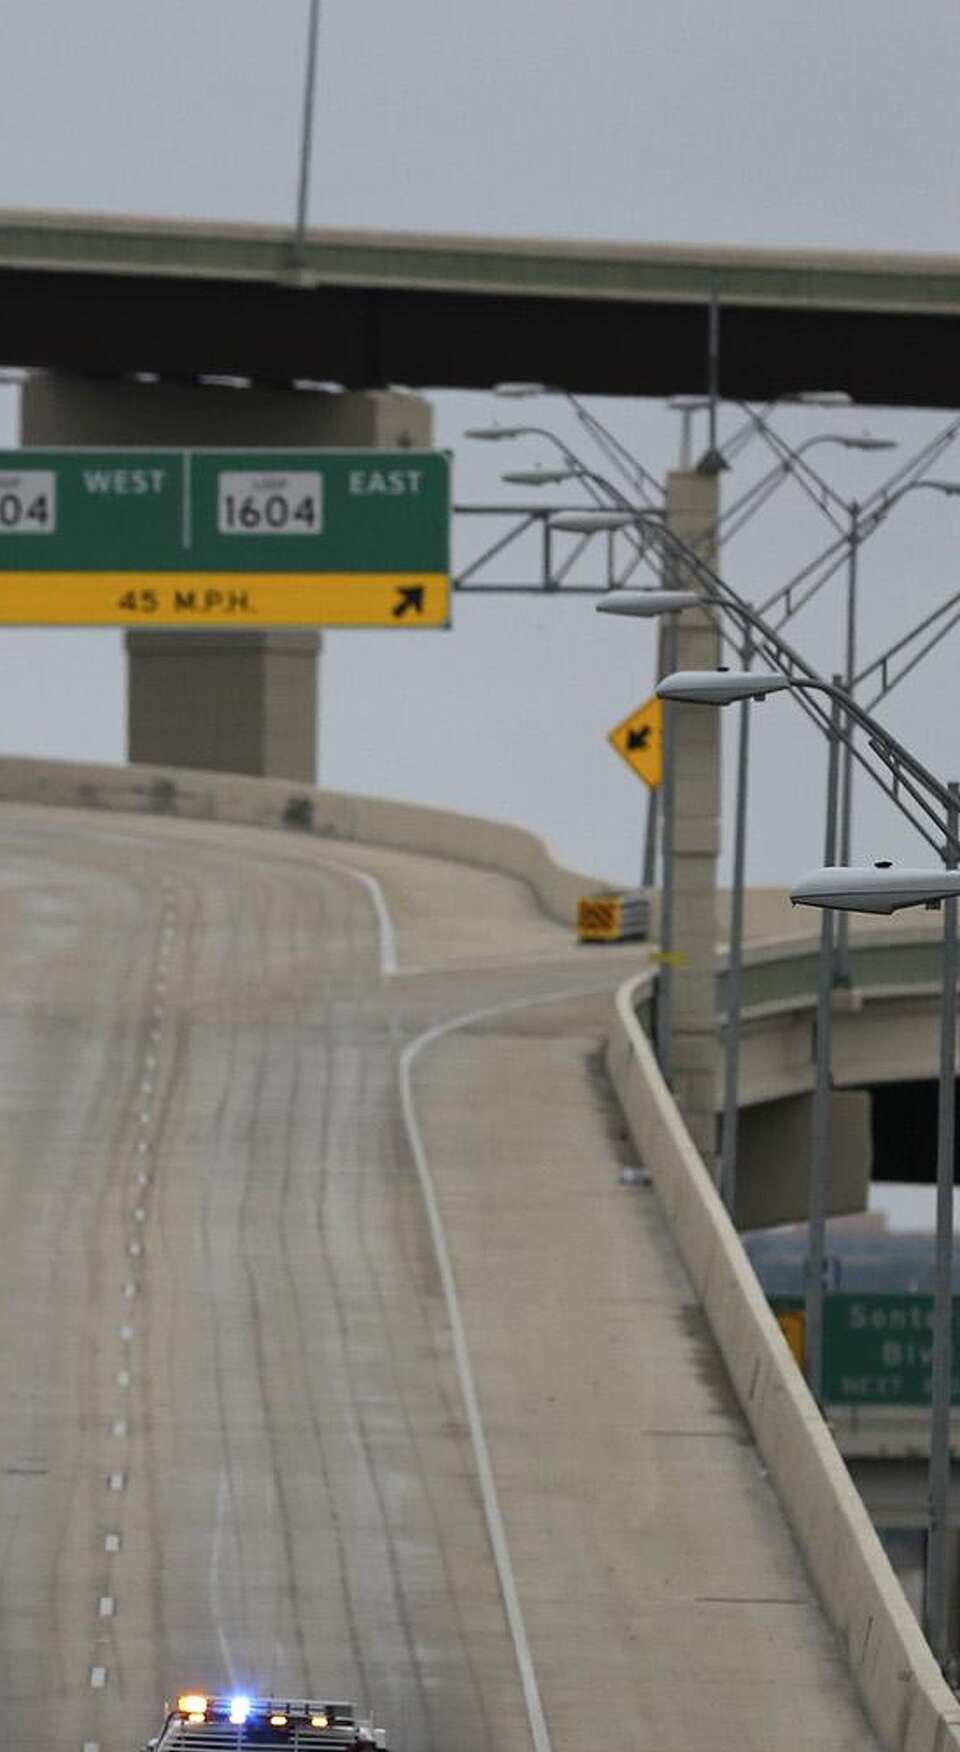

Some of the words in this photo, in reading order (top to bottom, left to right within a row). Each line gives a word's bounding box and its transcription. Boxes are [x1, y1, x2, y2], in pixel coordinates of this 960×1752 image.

[83, 470, 165, 494] WEST
[349, 470, 423, 494] EAST
[226, 495, 315, 528] 1604
[118, 589, 158, 613] 45
